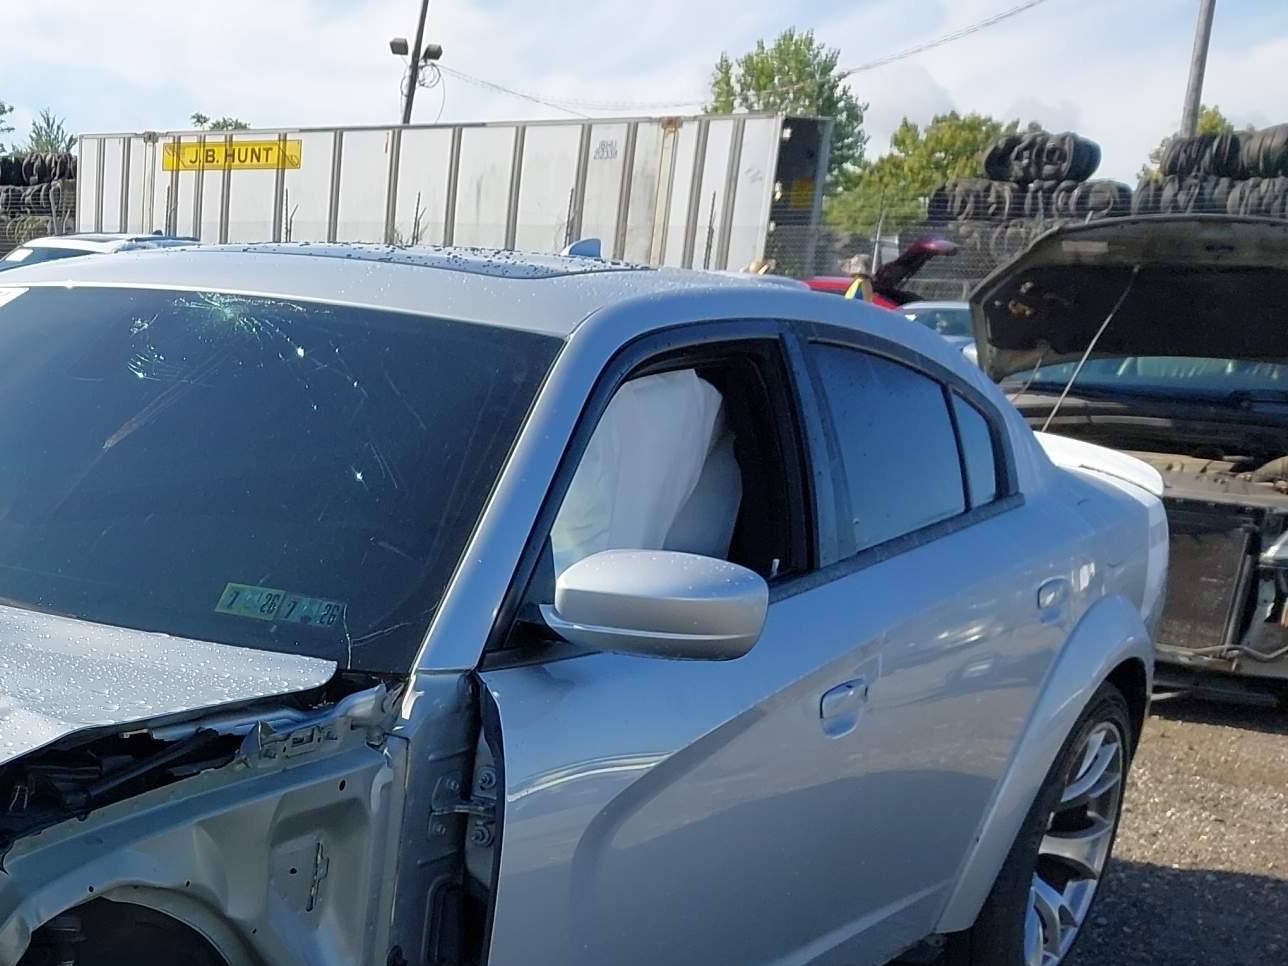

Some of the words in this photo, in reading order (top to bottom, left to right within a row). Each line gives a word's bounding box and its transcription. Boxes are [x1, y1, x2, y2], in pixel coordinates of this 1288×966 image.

[224, 147, 274, 164] HUNT
[259, 592, 281, 615] 26
[319, 603, 341, 625] 26
